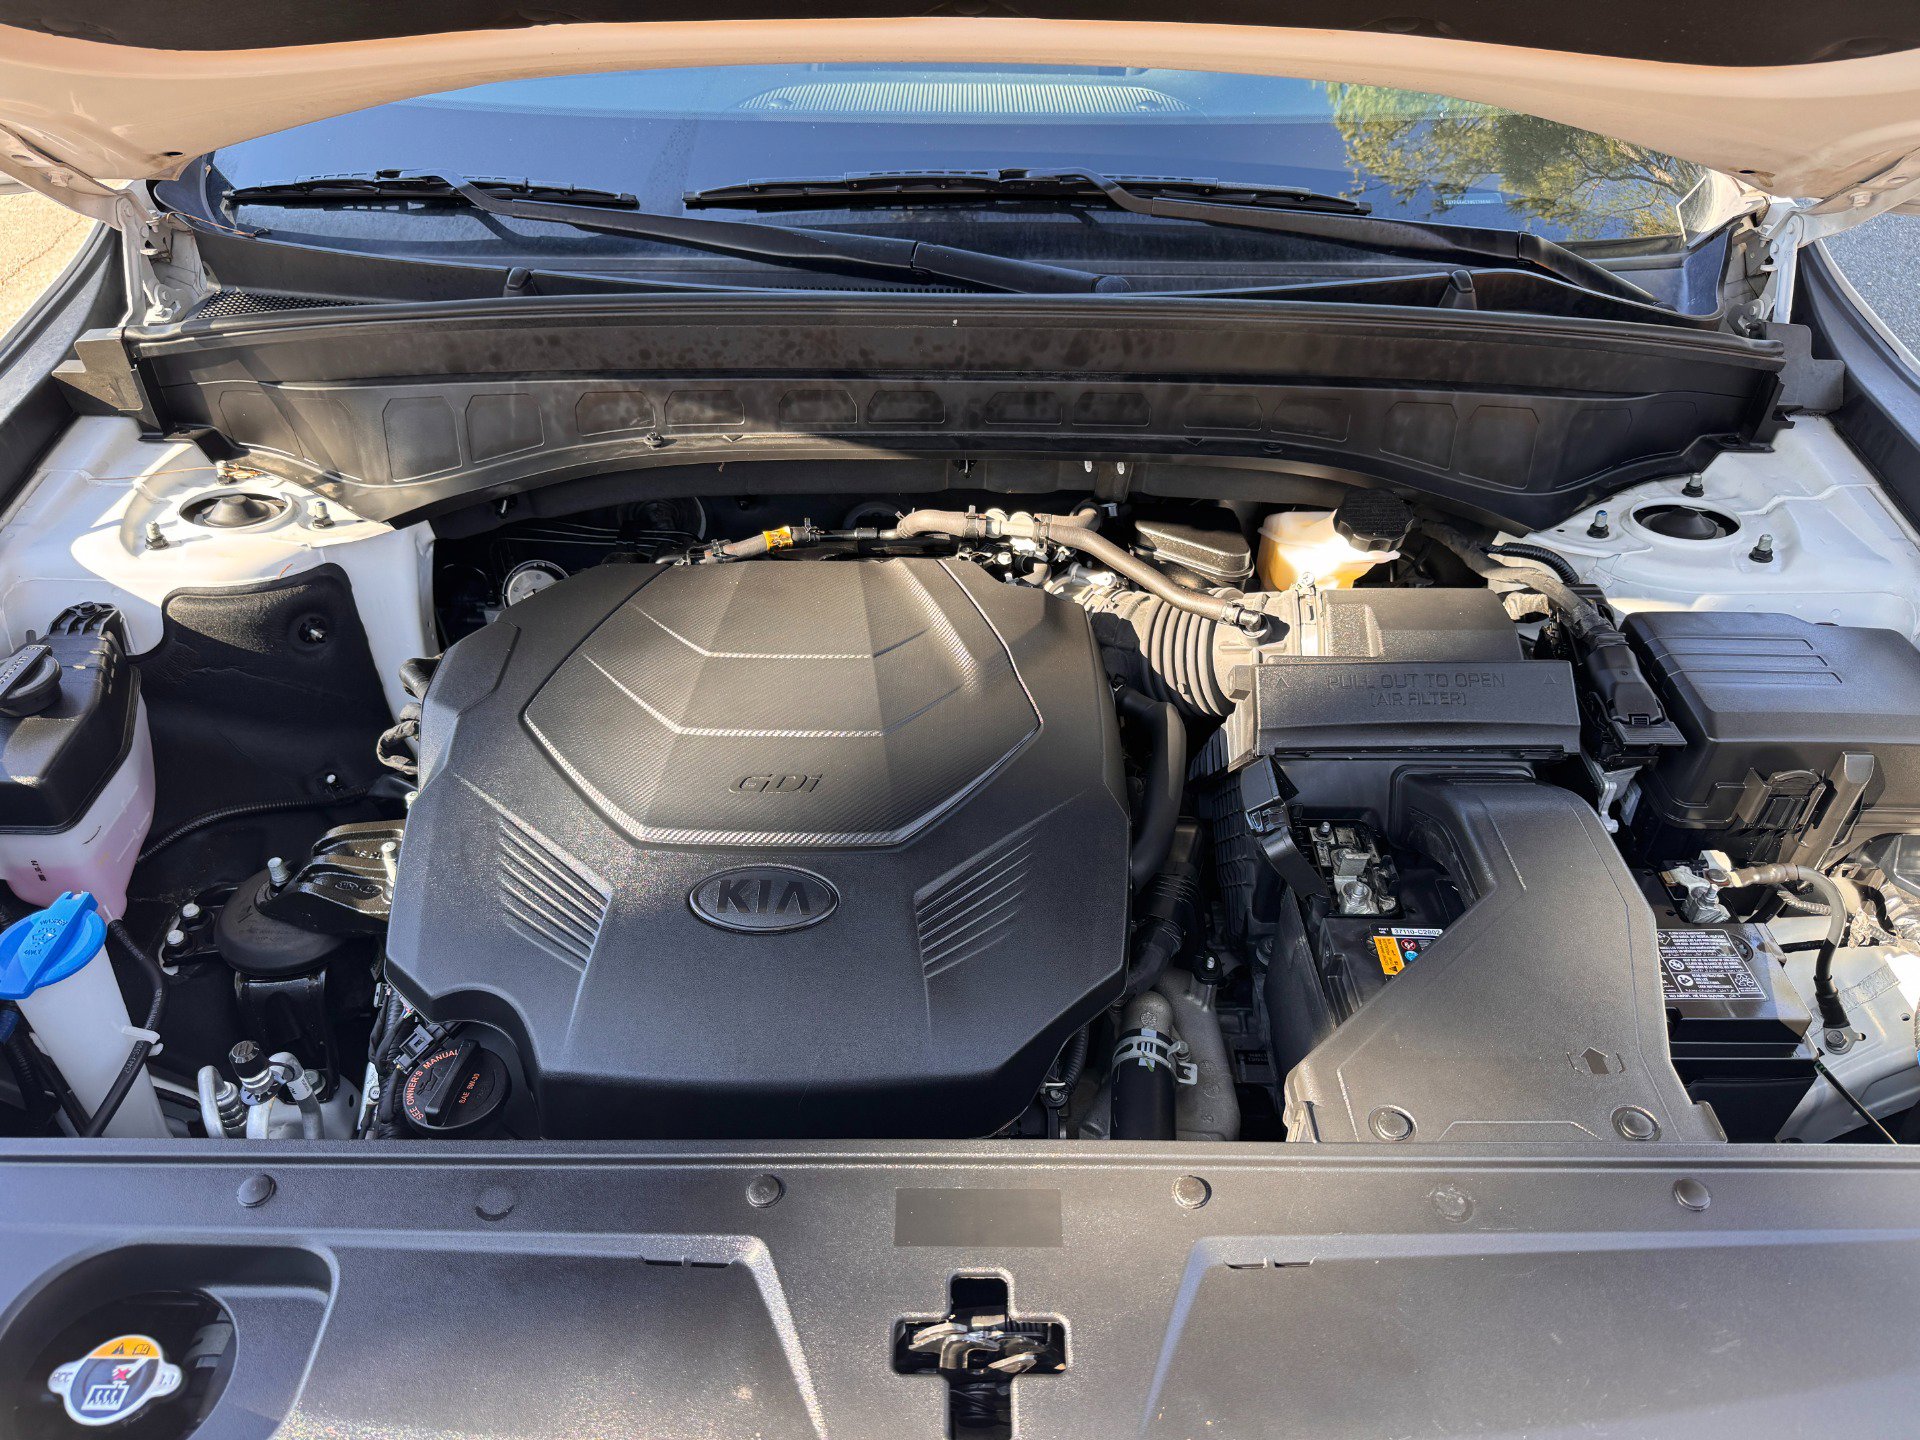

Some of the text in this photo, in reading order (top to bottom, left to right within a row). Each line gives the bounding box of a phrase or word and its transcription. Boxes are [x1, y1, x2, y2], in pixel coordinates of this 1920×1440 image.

[1327, 672, 1505, 689] PULL OUT TO OPEN
[1408, 691, 1467, 706] FILTER)
[716, 879, 811, 916] KIA
[406, 1049, 459, 1120] SEE OWNER'S MANUAL
[458, 1092, 470, 1104] SAE
